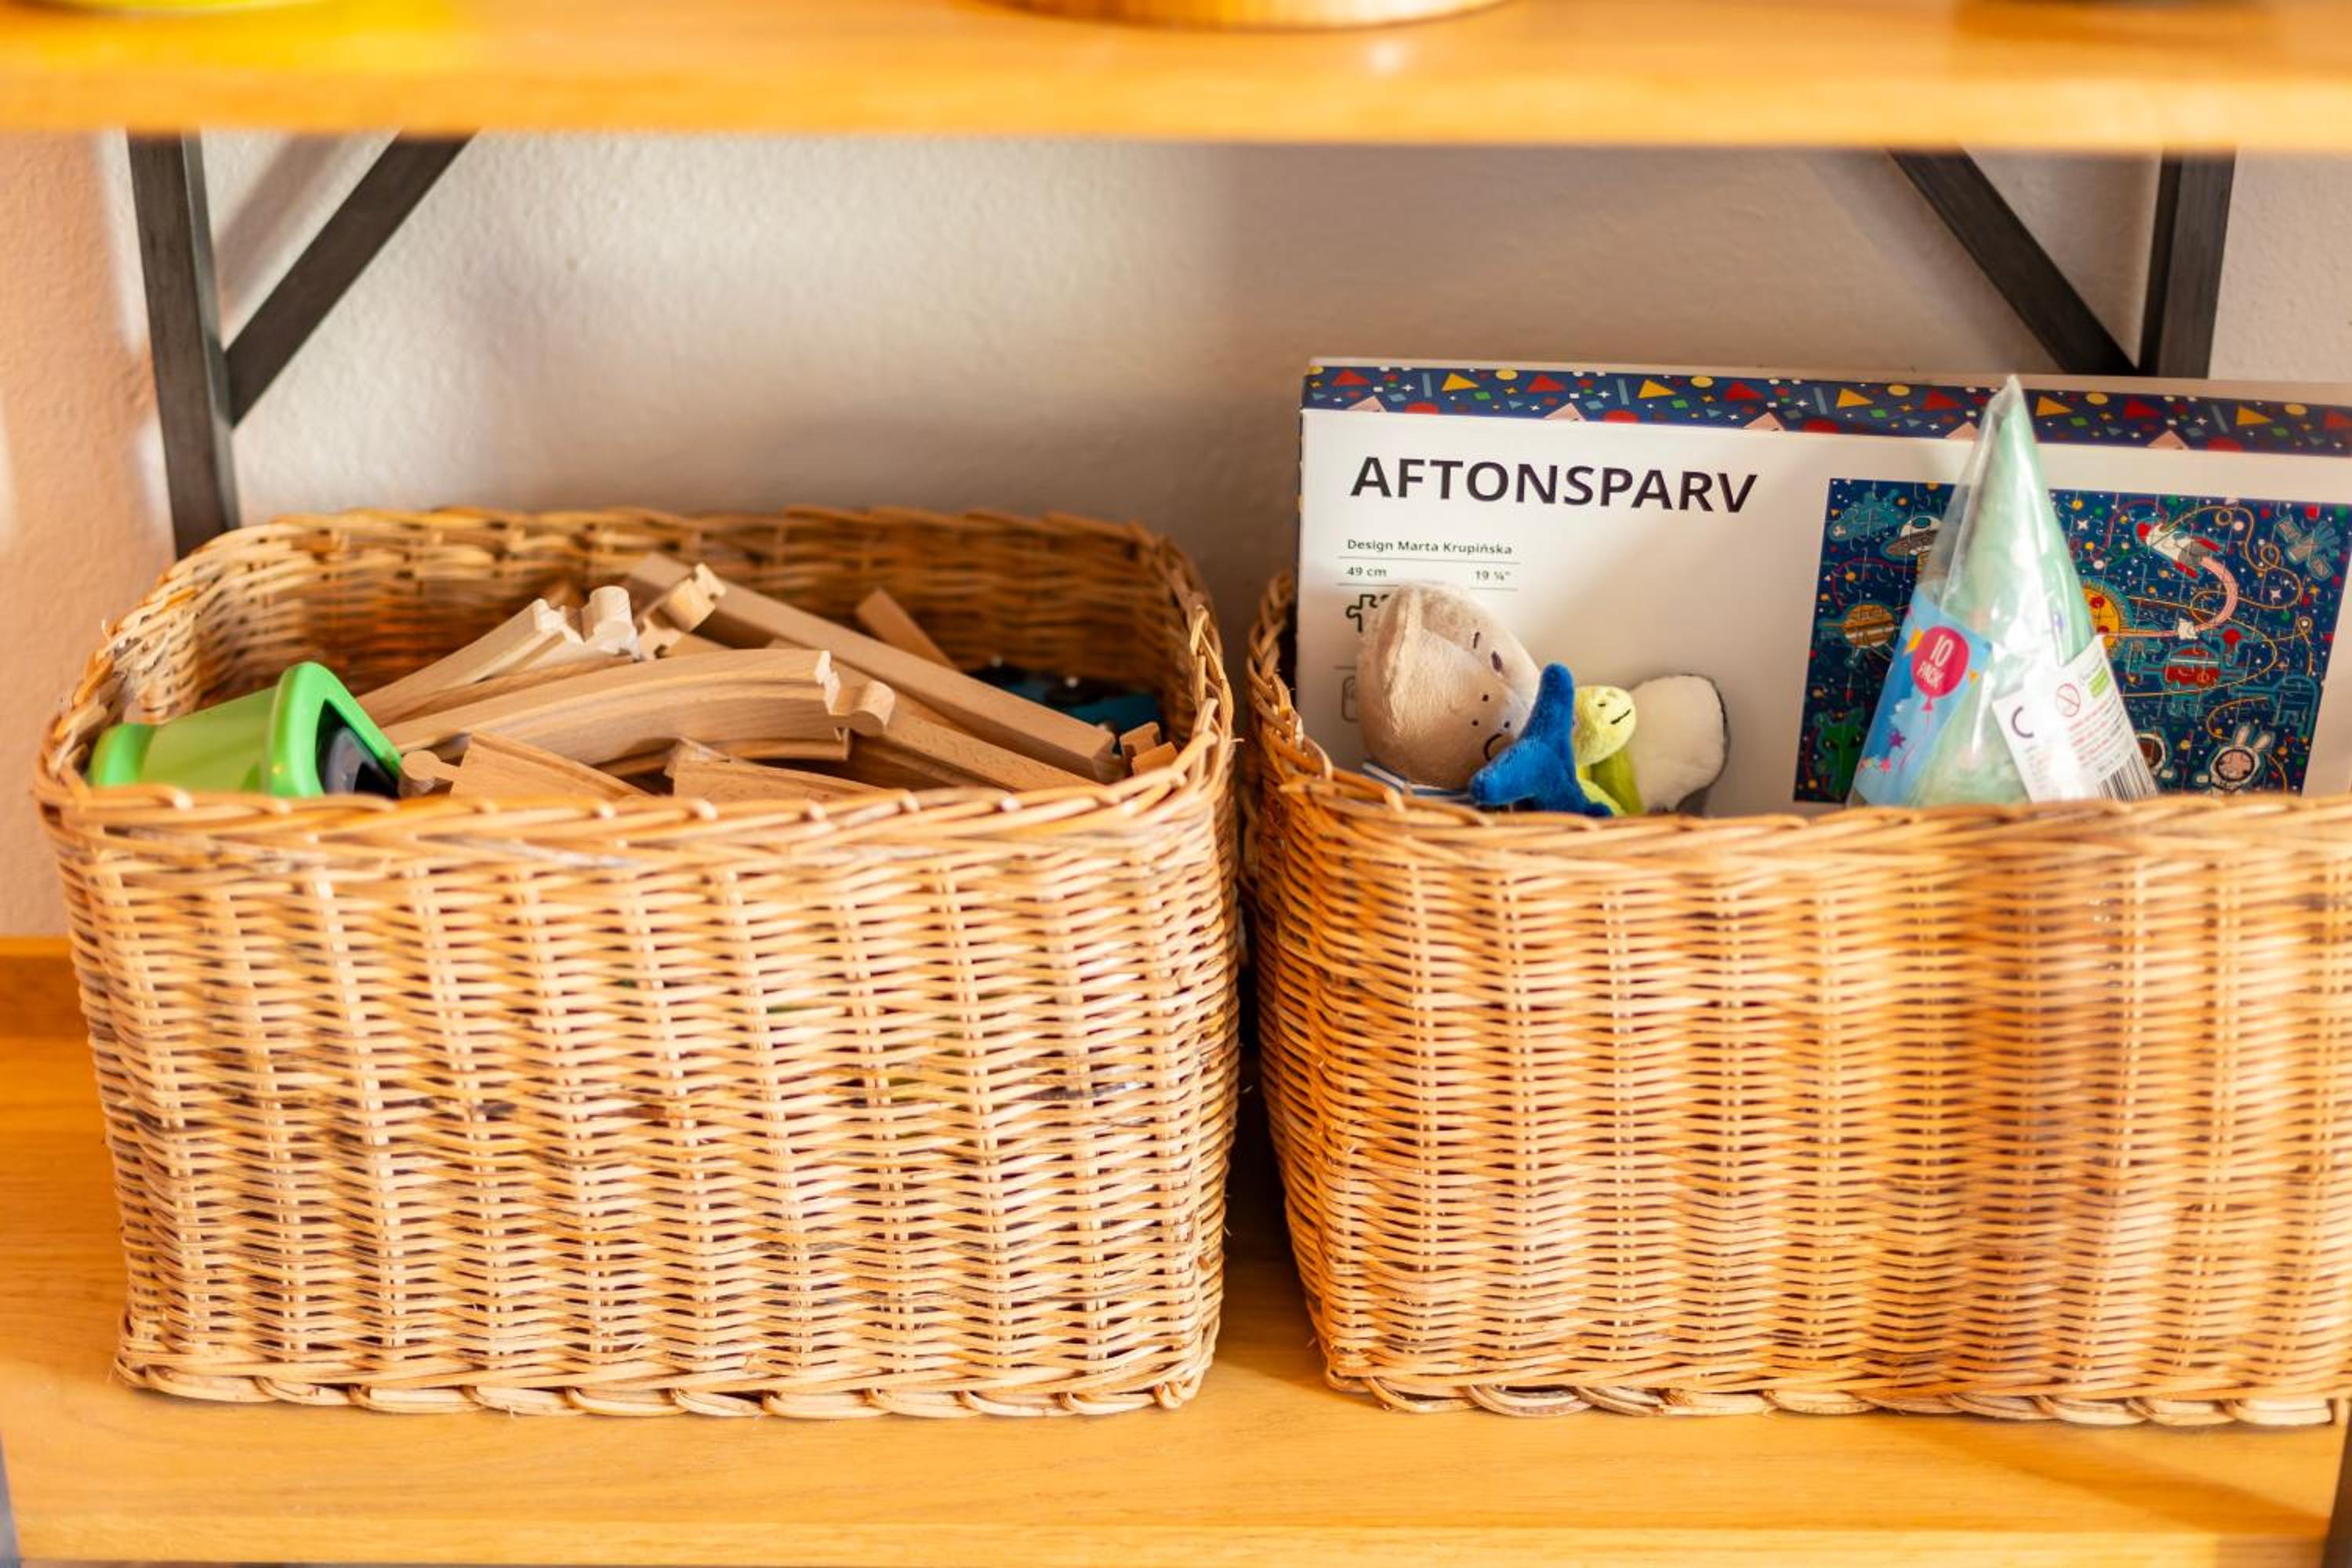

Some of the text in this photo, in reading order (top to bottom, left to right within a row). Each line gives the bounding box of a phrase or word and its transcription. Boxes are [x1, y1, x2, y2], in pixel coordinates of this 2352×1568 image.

[1349, 456, 1759, 514] AFTONSPARV
[1347, 539, 1512, 556] Design Marta Krupińska
[1346, 566, 1387, 577] 49 cm
[1475, 570, 1490, 579] 19
[1930, 634, 1954, 666] 10
